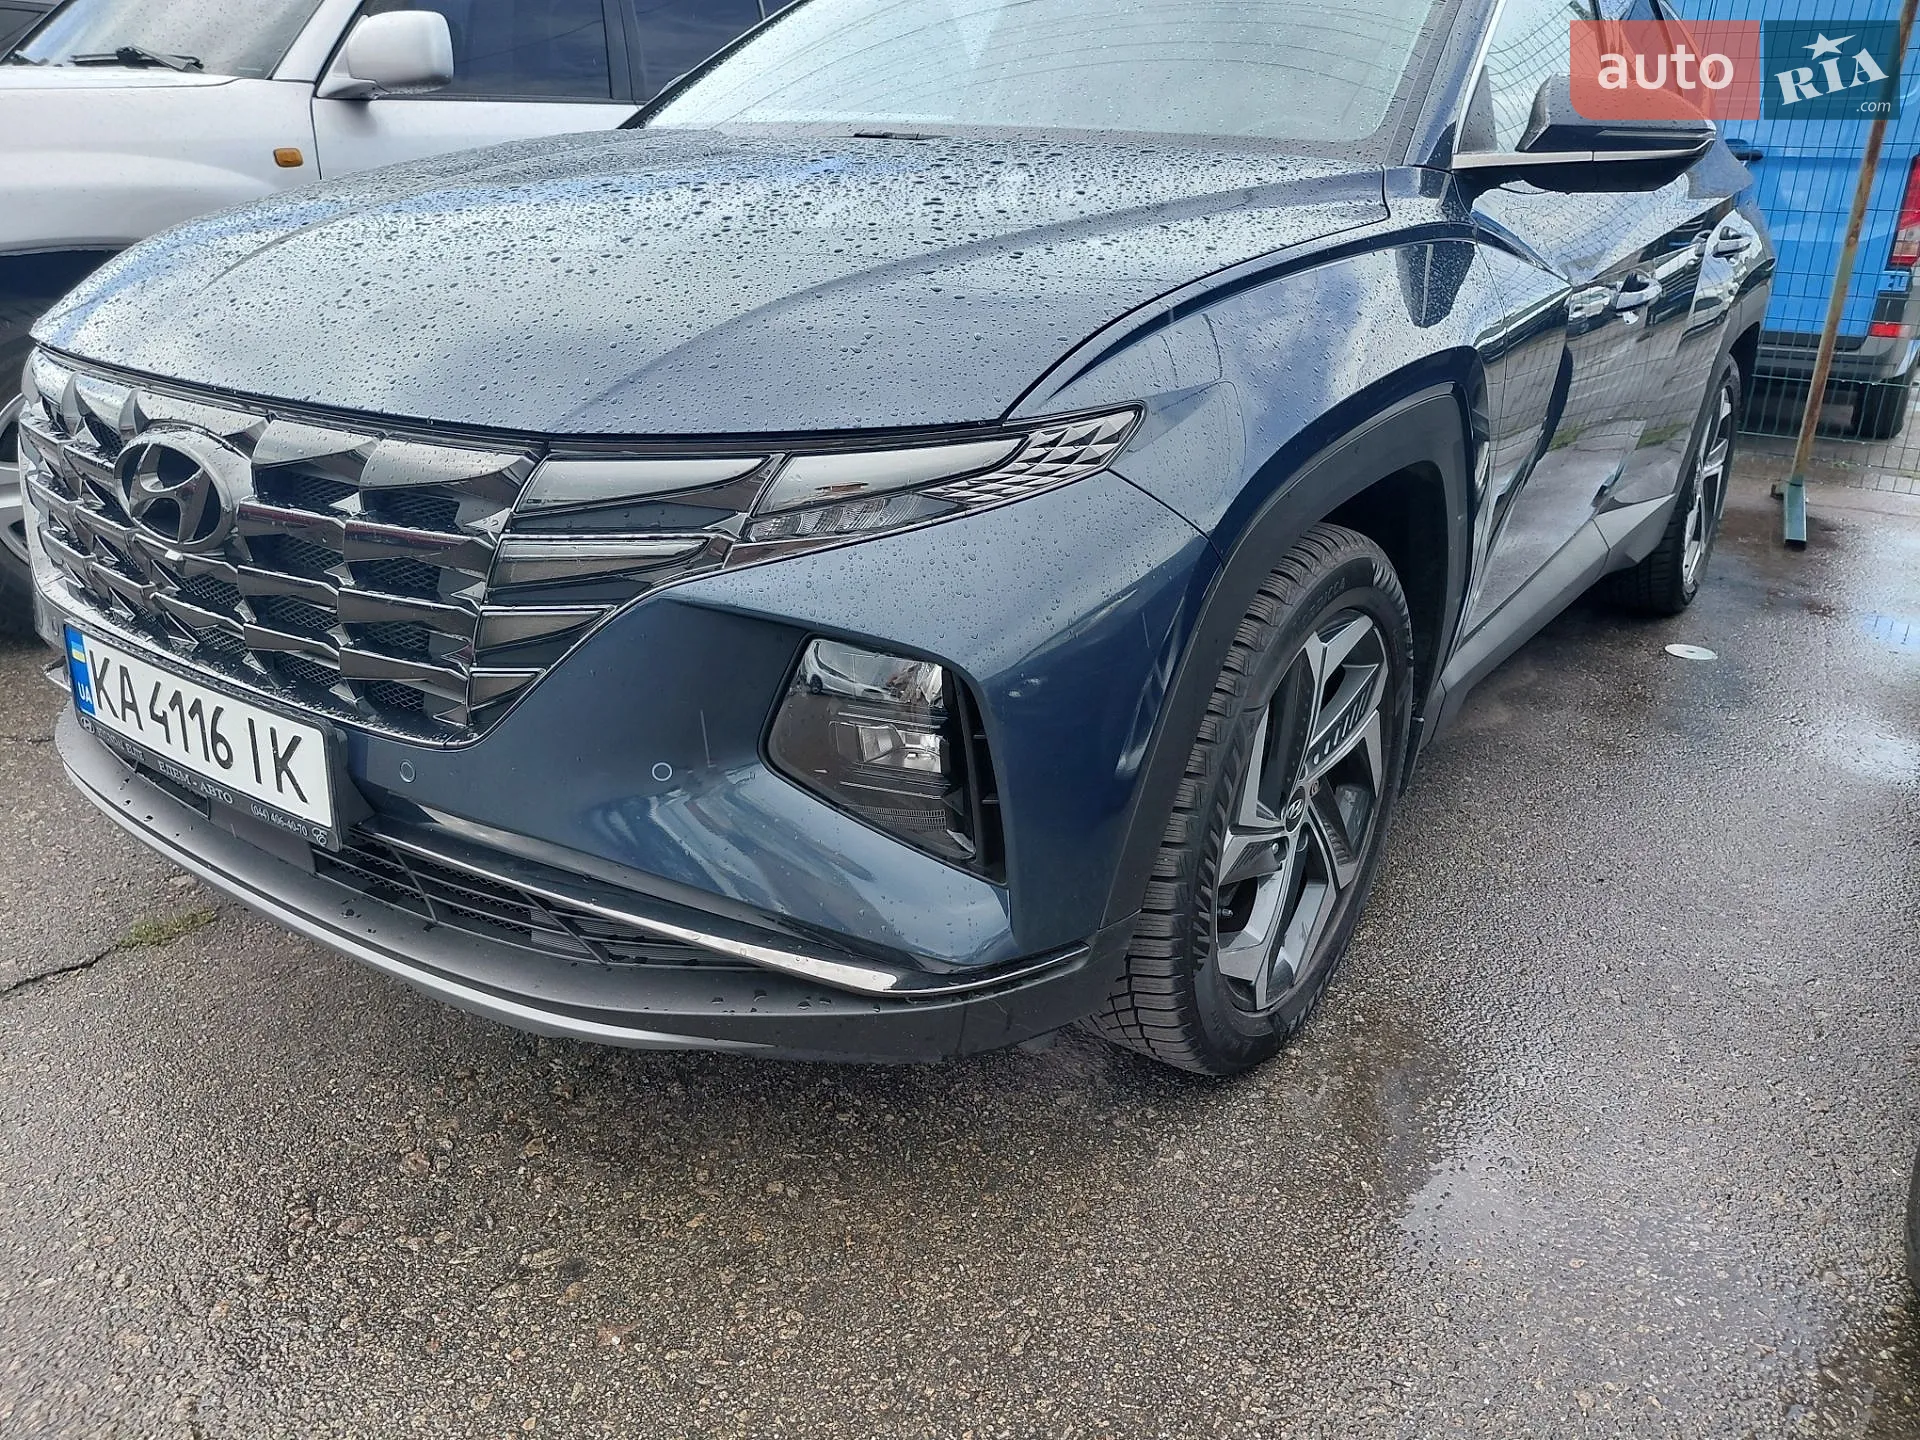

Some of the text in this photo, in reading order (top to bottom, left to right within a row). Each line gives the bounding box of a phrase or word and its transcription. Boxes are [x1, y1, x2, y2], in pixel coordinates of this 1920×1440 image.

[77, 680, 93, 705] UA
[89, 649, 310, 805] KA 4116 IK
